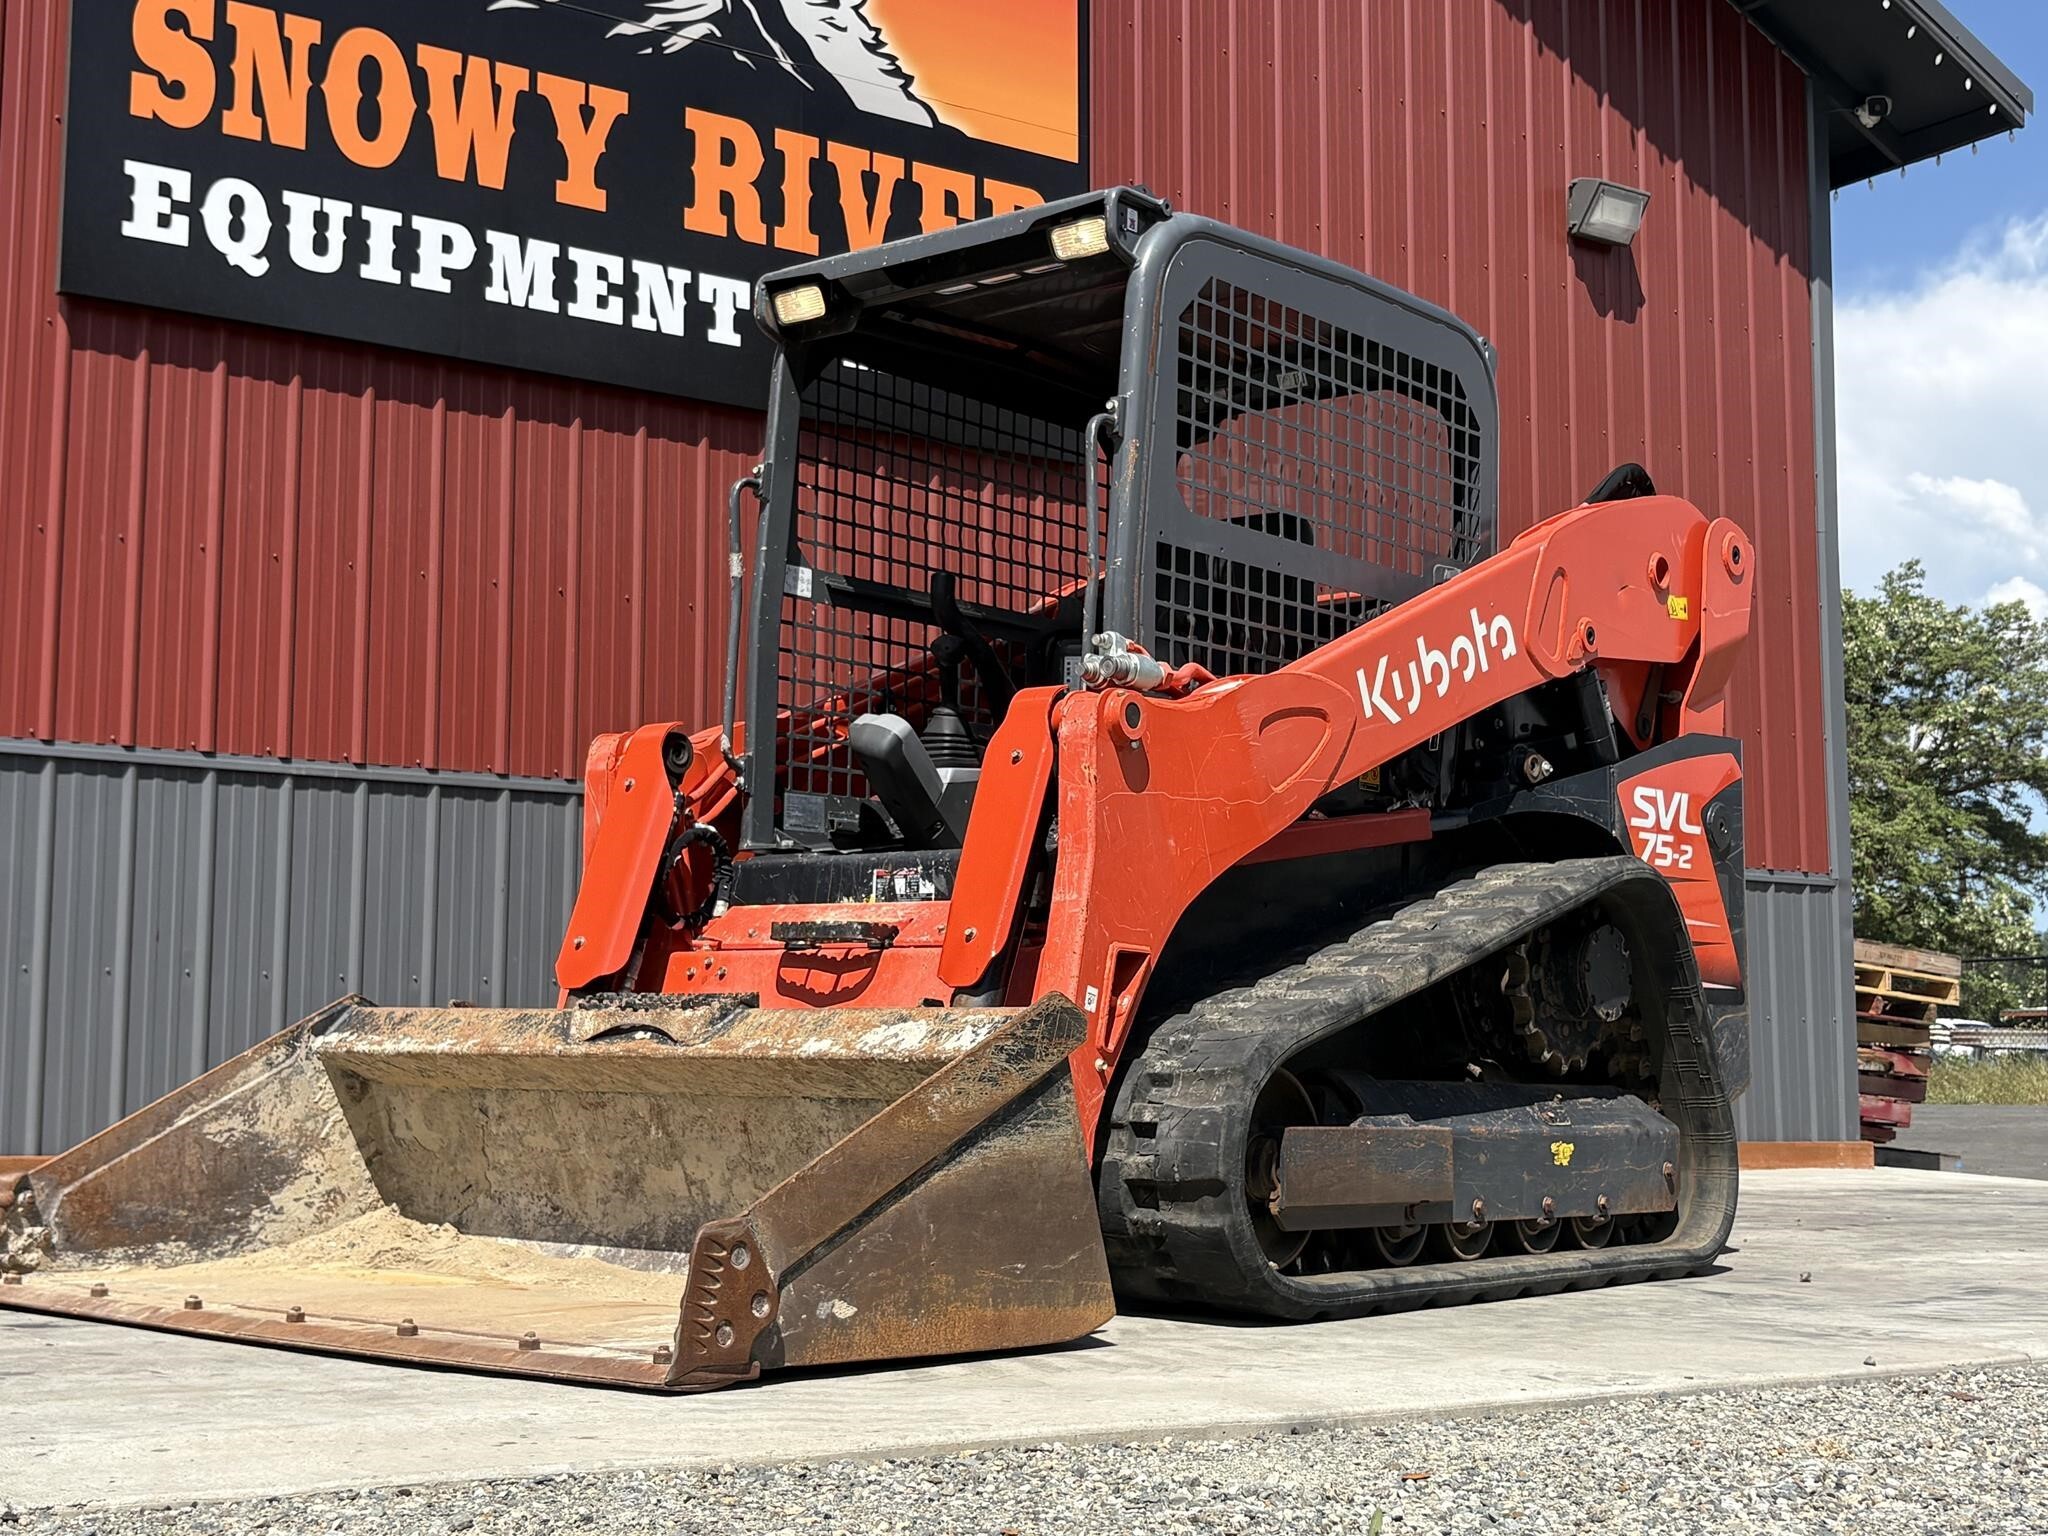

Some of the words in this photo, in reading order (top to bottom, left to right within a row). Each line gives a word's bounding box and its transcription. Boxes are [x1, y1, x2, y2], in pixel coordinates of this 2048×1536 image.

[129, 0, 629, 213] SNOWY
[120, 158, 752, 348] EQUIPMENT
[1356, 607, 1517, 725] Kubota
[1630, 785, 1702, 835] SVL
[1638, 831, 1693, 870] 75-2
